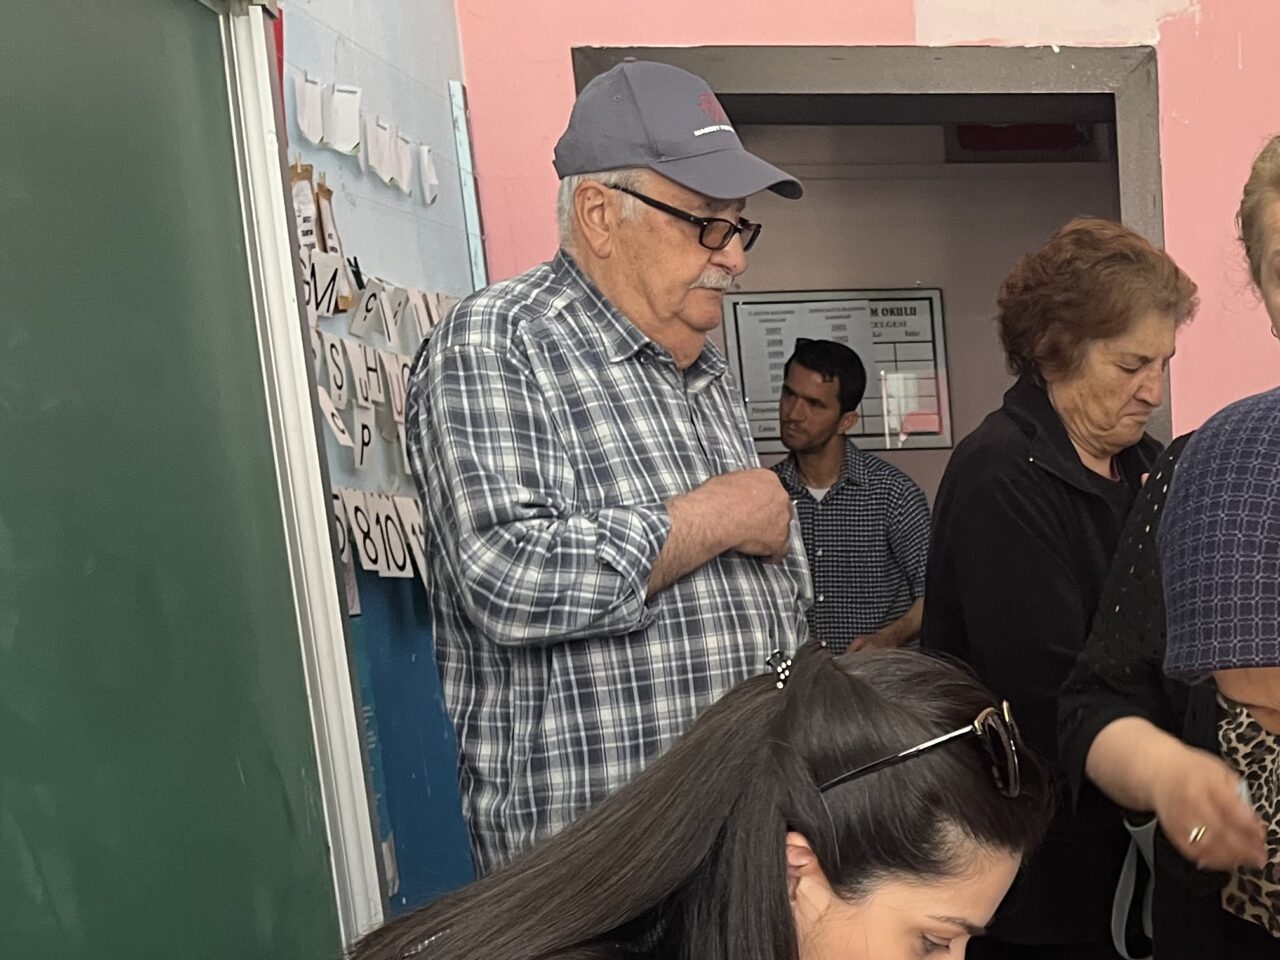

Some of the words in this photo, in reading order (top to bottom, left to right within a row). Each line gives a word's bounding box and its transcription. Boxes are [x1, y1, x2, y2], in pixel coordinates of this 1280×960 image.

[310, 262, 339, 313] M
[881, 306, 917, 317] OKULU
[354, 505, 378, 565] 8
[376, 512, 407, 572] 10
